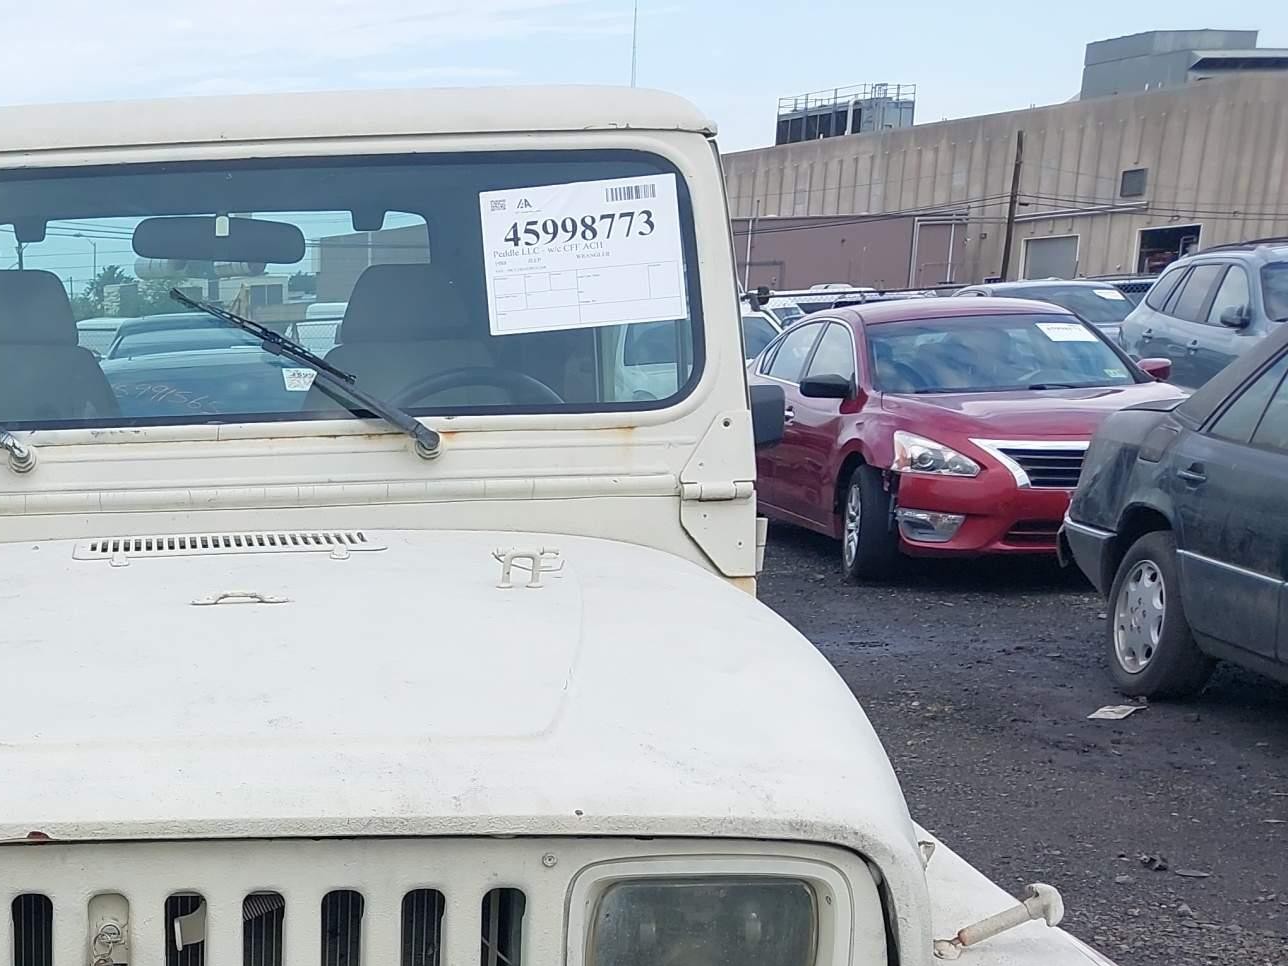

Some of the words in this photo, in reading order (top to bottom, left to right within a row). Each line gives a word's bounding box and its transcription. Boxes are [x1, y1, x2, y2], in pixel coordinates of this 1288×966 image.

[504, 210, 655, 247] 45998773
[493, 247, 520, 258] Peddle
[522, 247, 541, 256] LLC
